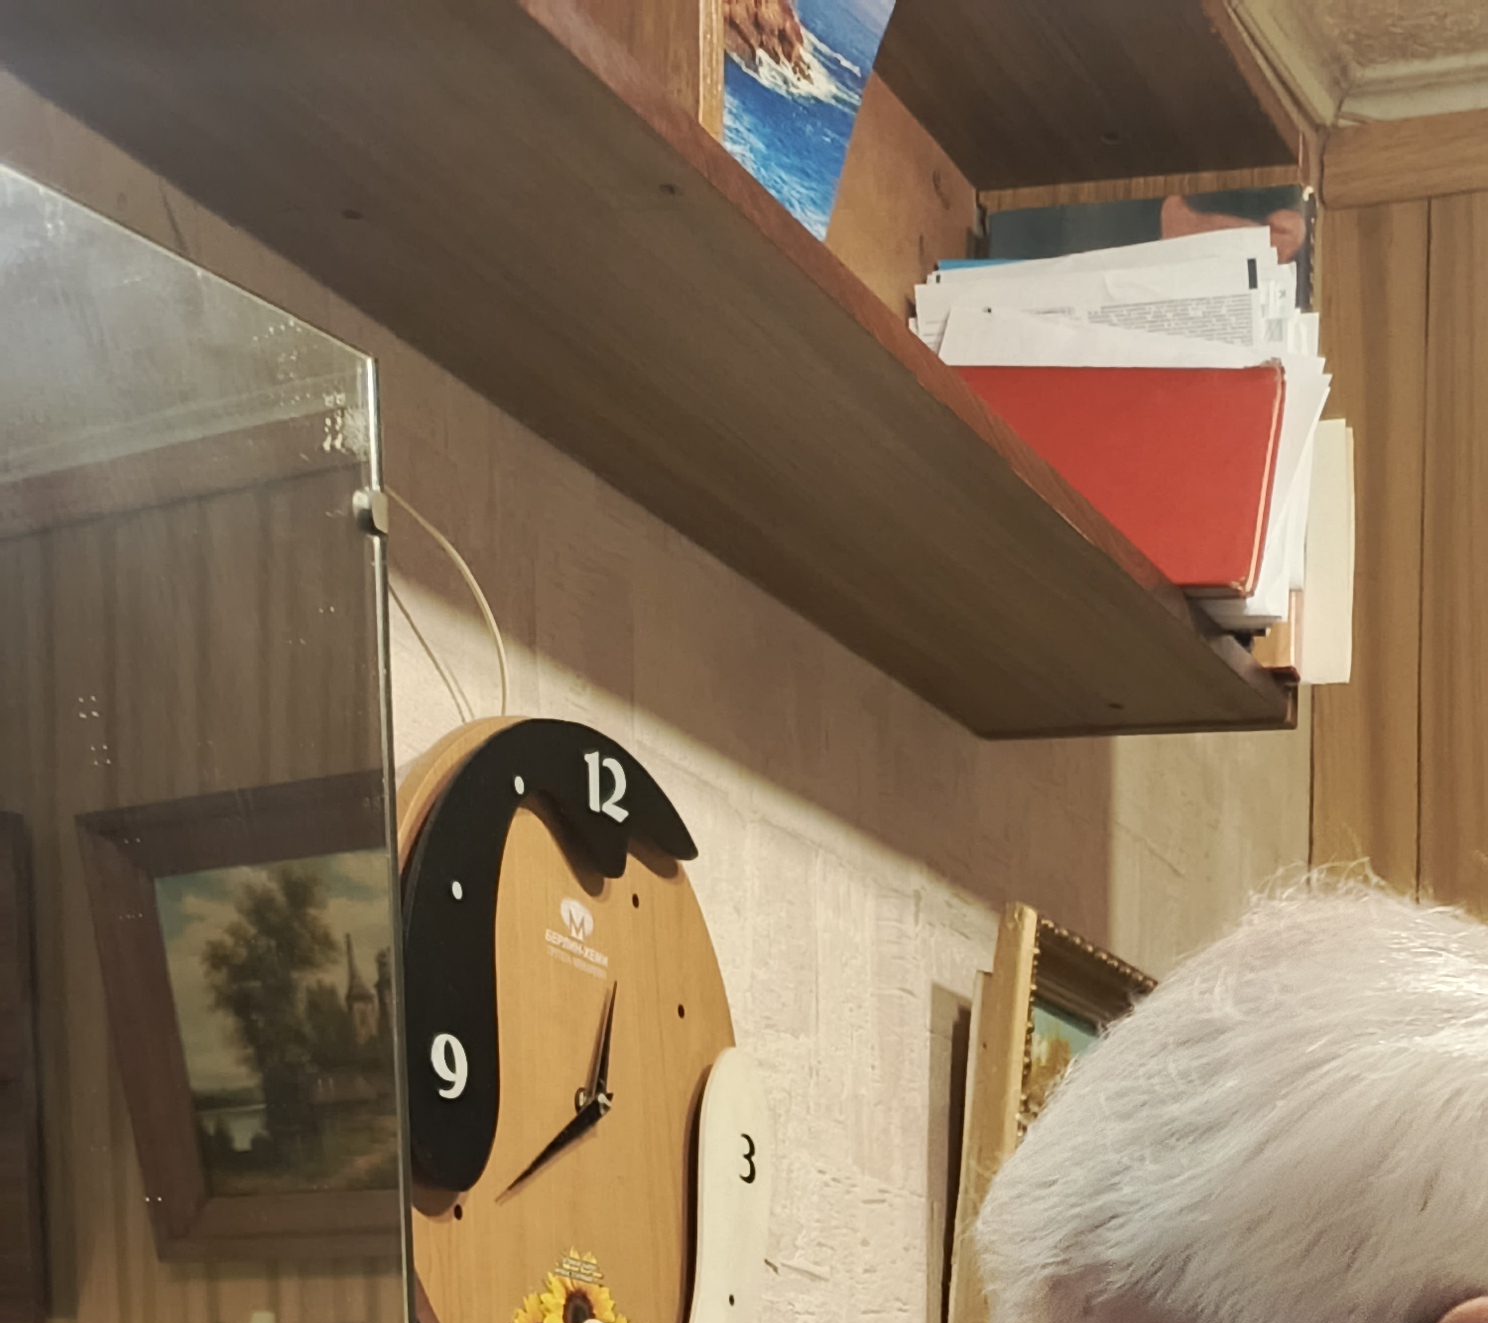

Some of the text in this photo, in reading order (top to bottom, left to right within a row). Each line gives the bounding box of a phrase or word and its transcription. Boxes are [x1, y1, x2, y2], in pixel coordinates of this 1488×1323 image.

[584, 751, 629, 823] 12
[431, 1034, 468, 1099] 9
[738, 1133, 756, 1184] 3
